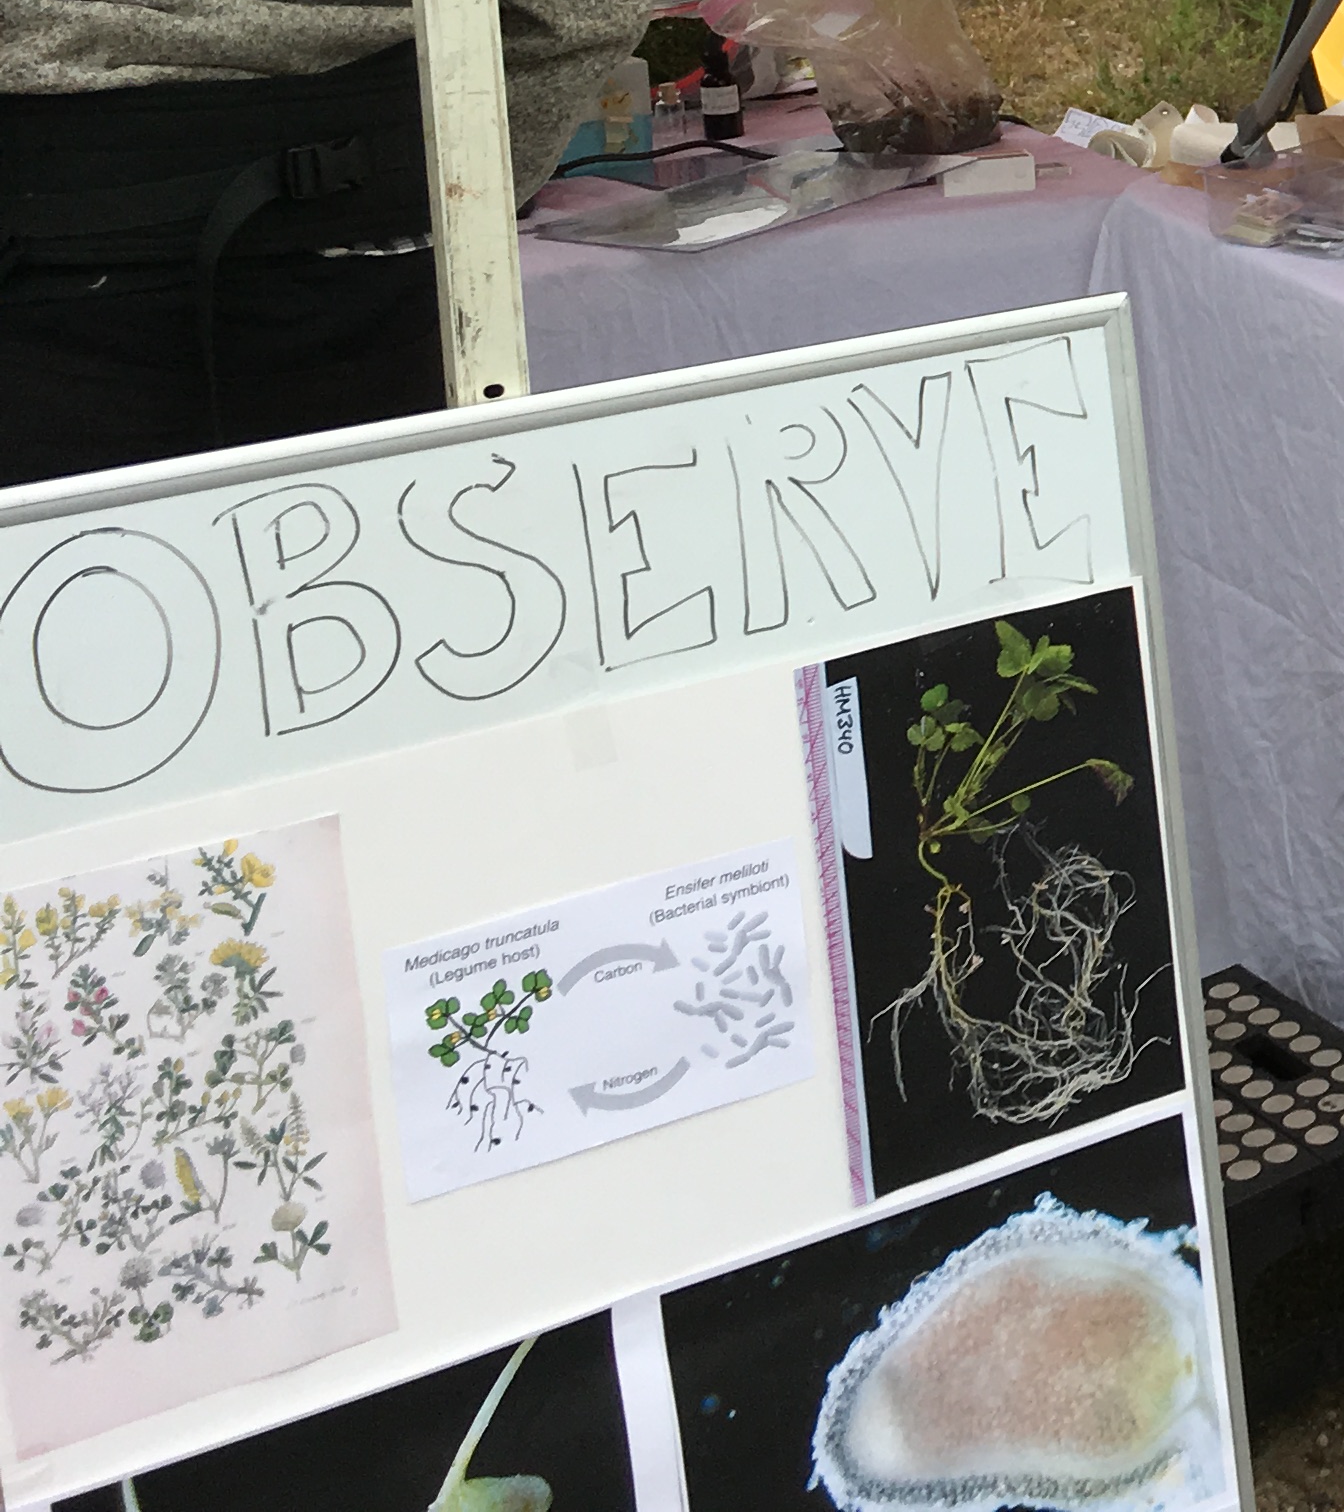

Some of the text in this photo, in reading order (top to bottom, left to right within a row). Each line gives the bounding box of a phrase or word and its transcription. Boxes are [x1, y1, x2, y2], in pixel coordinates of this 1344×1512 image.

[0, 335, 1096, 794] OBSERVE
[834, 685, 854, 755] HM340
[650, 874, 790, 926] (Bacterial symbiont)
[665, 859, 770, 900] Ensifer meliloti
[405, 919, 560, 972] Medicago truncatula
[430, 944, 541, 988] (Legume host)
[594, 961, 643, 983] Carbon
[602, 1066, 658, 1091] Nitrogen
